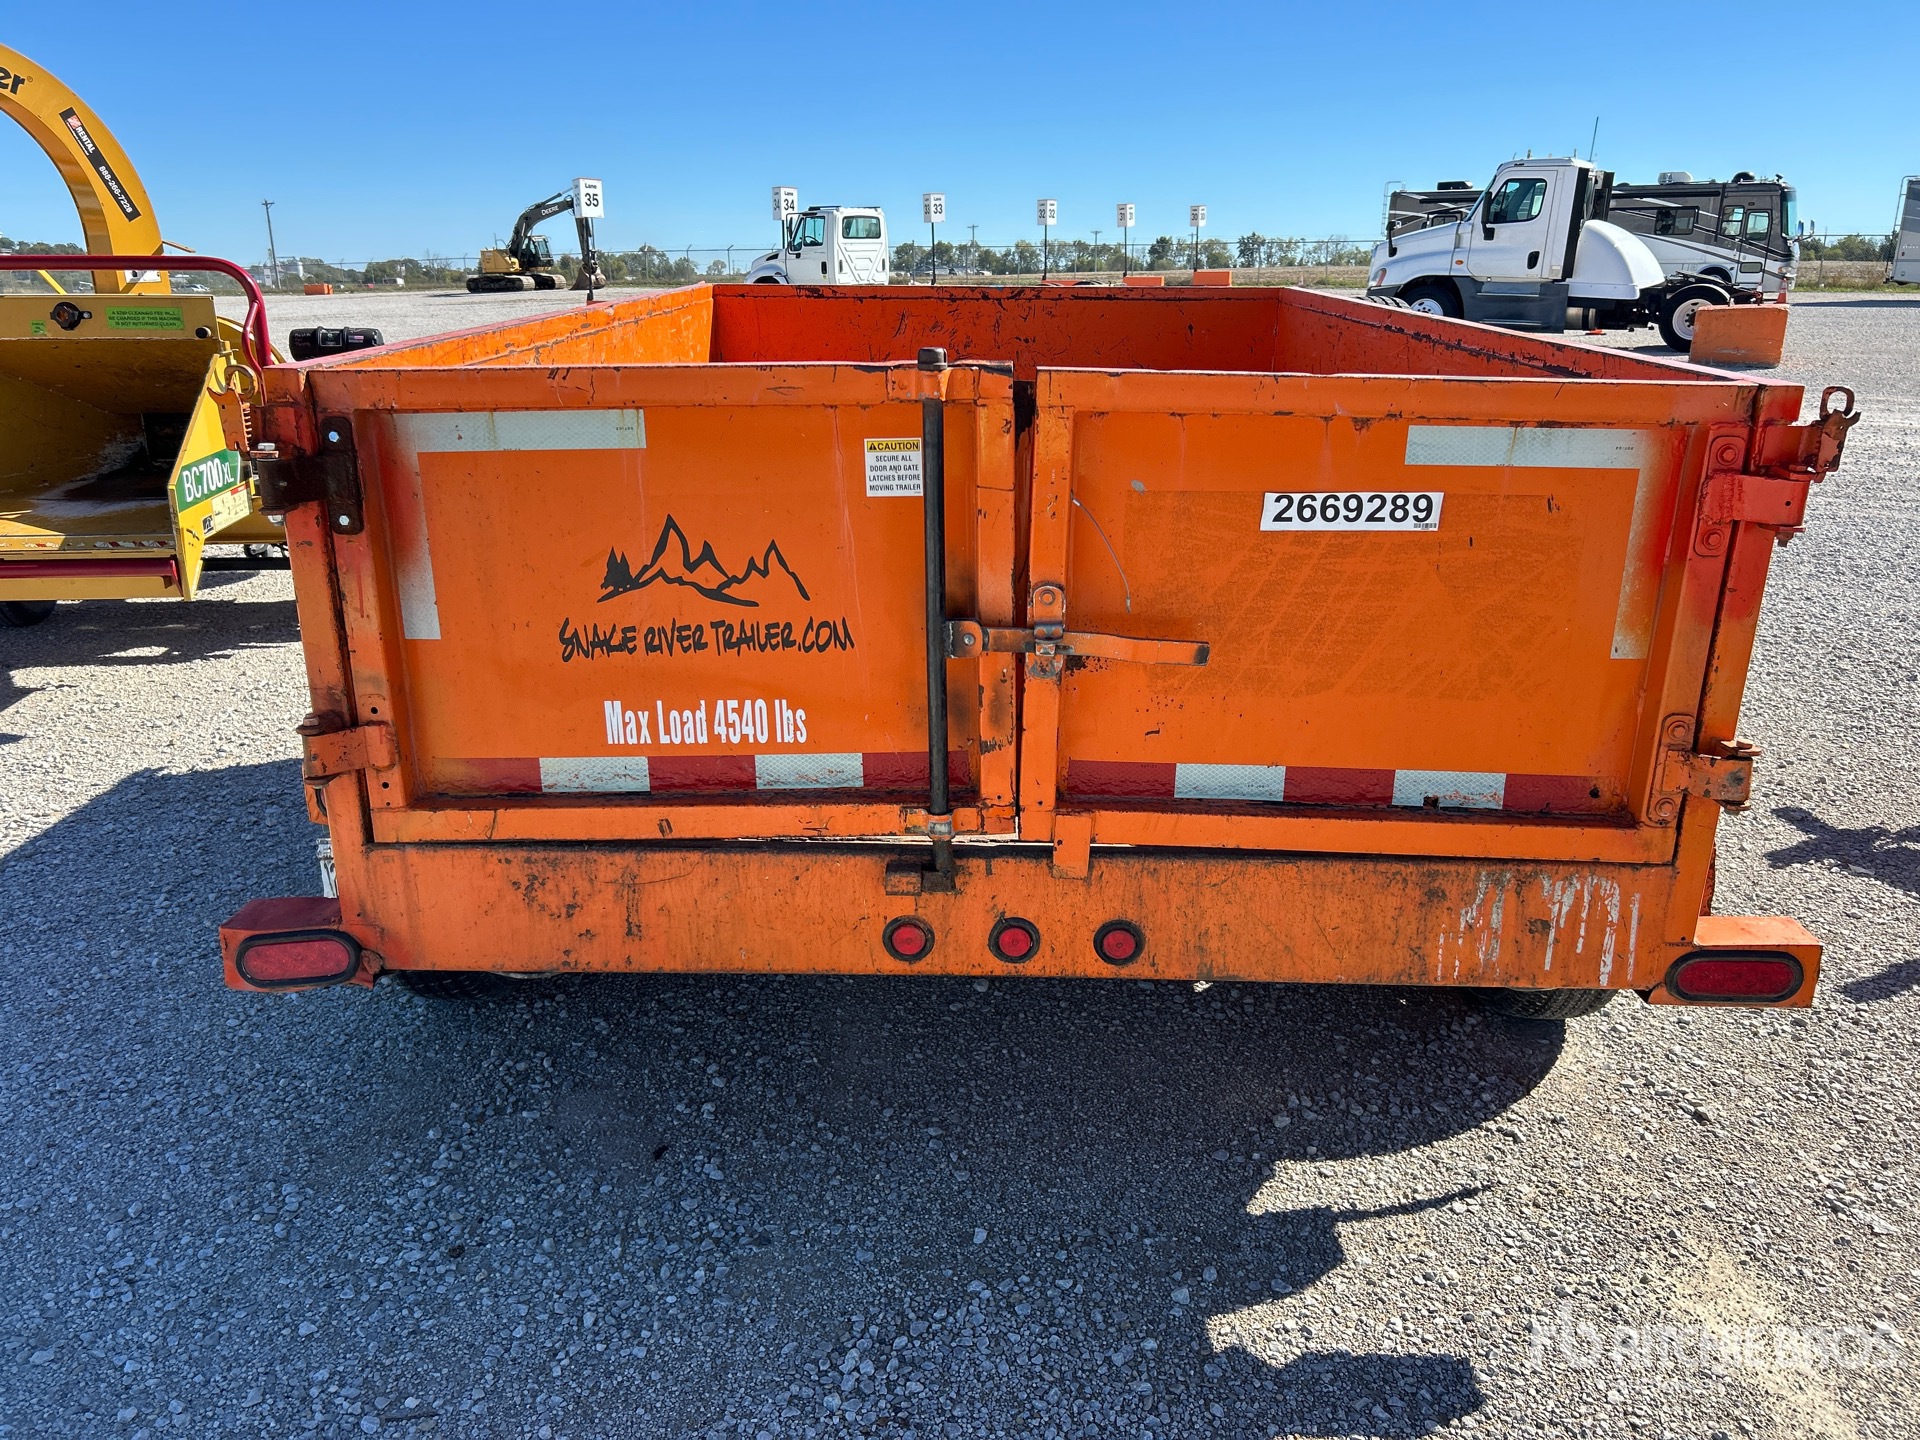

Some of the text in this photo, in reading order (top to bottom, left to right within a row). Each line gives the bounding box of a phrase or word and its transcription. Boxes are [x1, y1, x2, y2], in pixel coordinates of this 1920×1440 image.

[76, 126, 96, 153] RENTAL
[584, 193, 599, 207] 35
[783, 199, 795, 211] 34
[541, 205, 559, 215] DEERE
[933, 204, 943, 214] 33
[1038, 209, 1046, 219] 32
[877, 442, 919, 451] CAUTION
[869, 474, 896, 482] LATCHES
[895, 483, 921, 491] TRAILER
[1272, 493, 1434, 523] 2669289
[558, 617, 637, 663] SNAKE
[644, 617, 708, 659] RIVER
[603, 699, 808, 745] Max Load 4540 lbs
